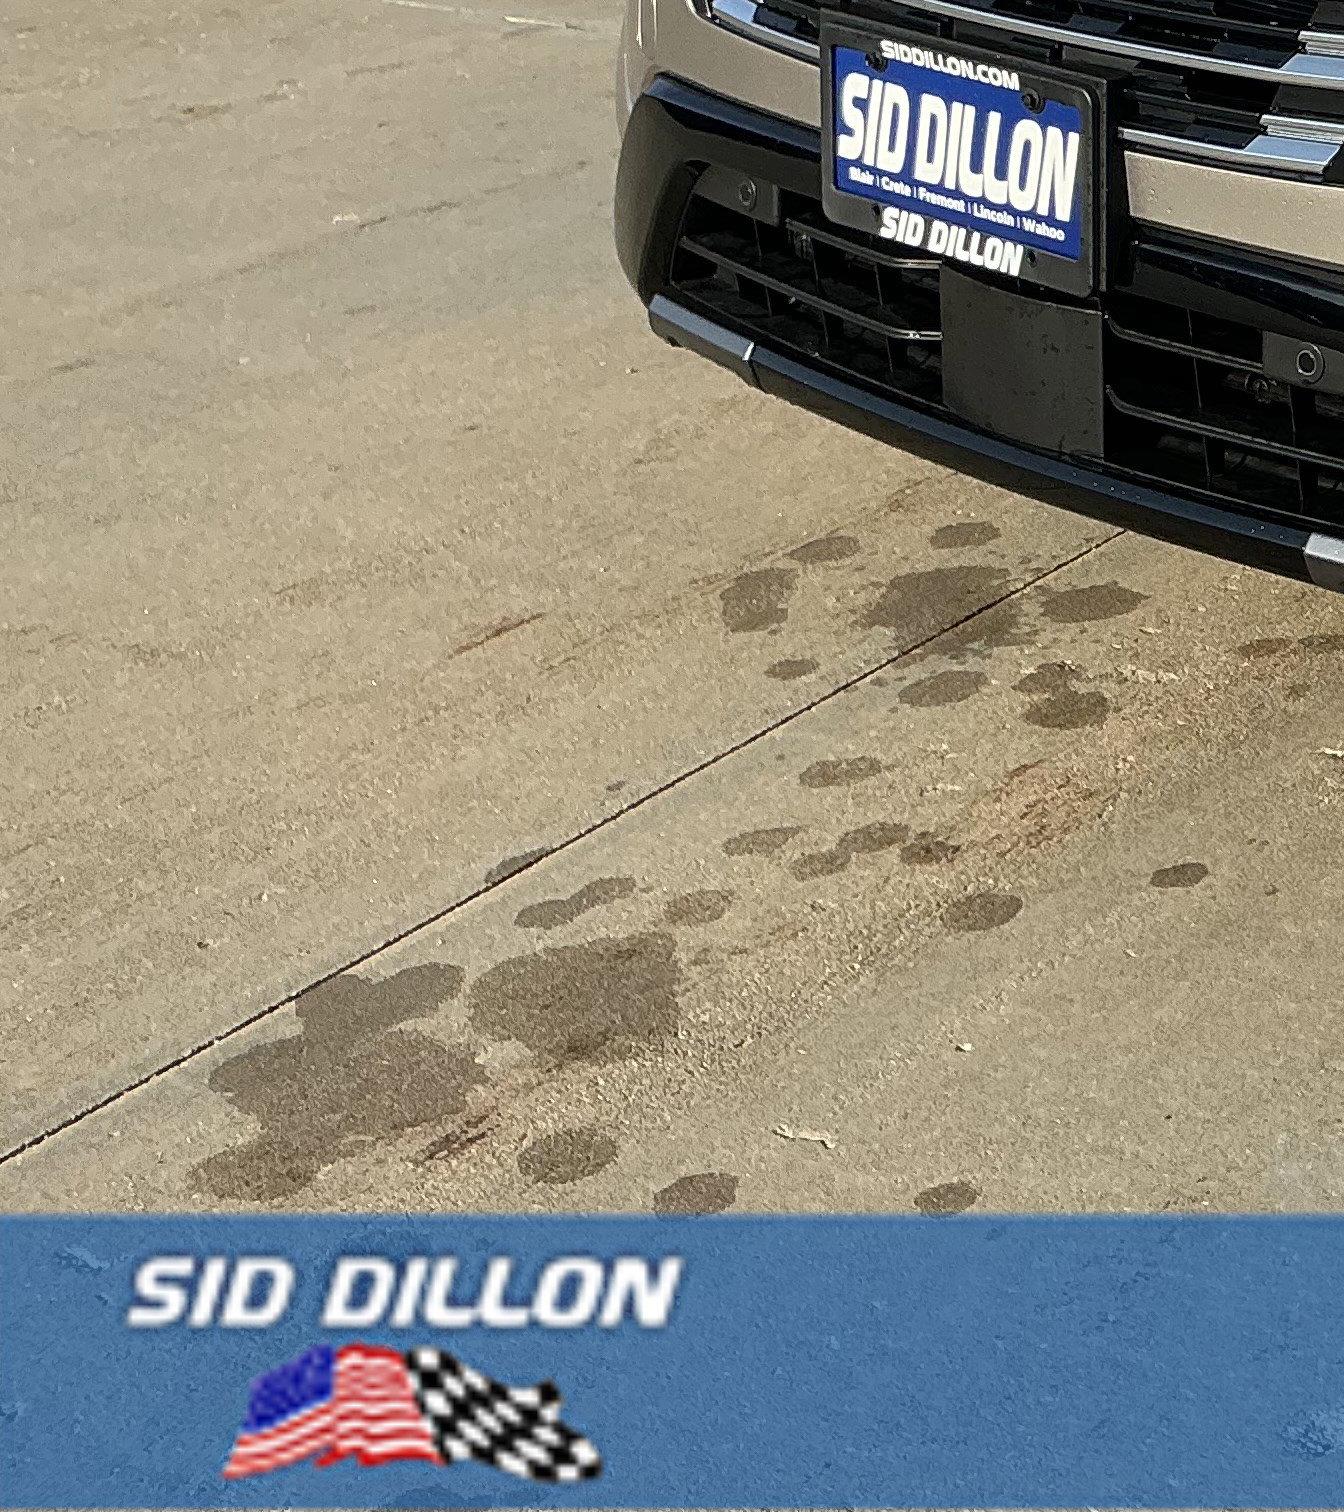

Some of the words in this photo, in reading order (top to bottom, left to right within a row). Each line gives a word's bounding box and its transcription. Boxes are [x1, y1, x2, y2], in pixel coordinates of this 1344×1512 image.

[880, 39, 1021, 91] SIDDILLON.COM
[837, 72, 910, 174] SID
[914, 93, 1080, 222] DILLON
[849, 167, 875, 187] Blair
[881, 176, 911, 197] Crete
[919, 187, 966, 213] Fremont
[973, 202, 1015, 227] Lincoln
[1022, 216, 1065, 241] Wahoo
[880, 206, 926, 247] SID
[927, 220, 1024, 276] DILLON
